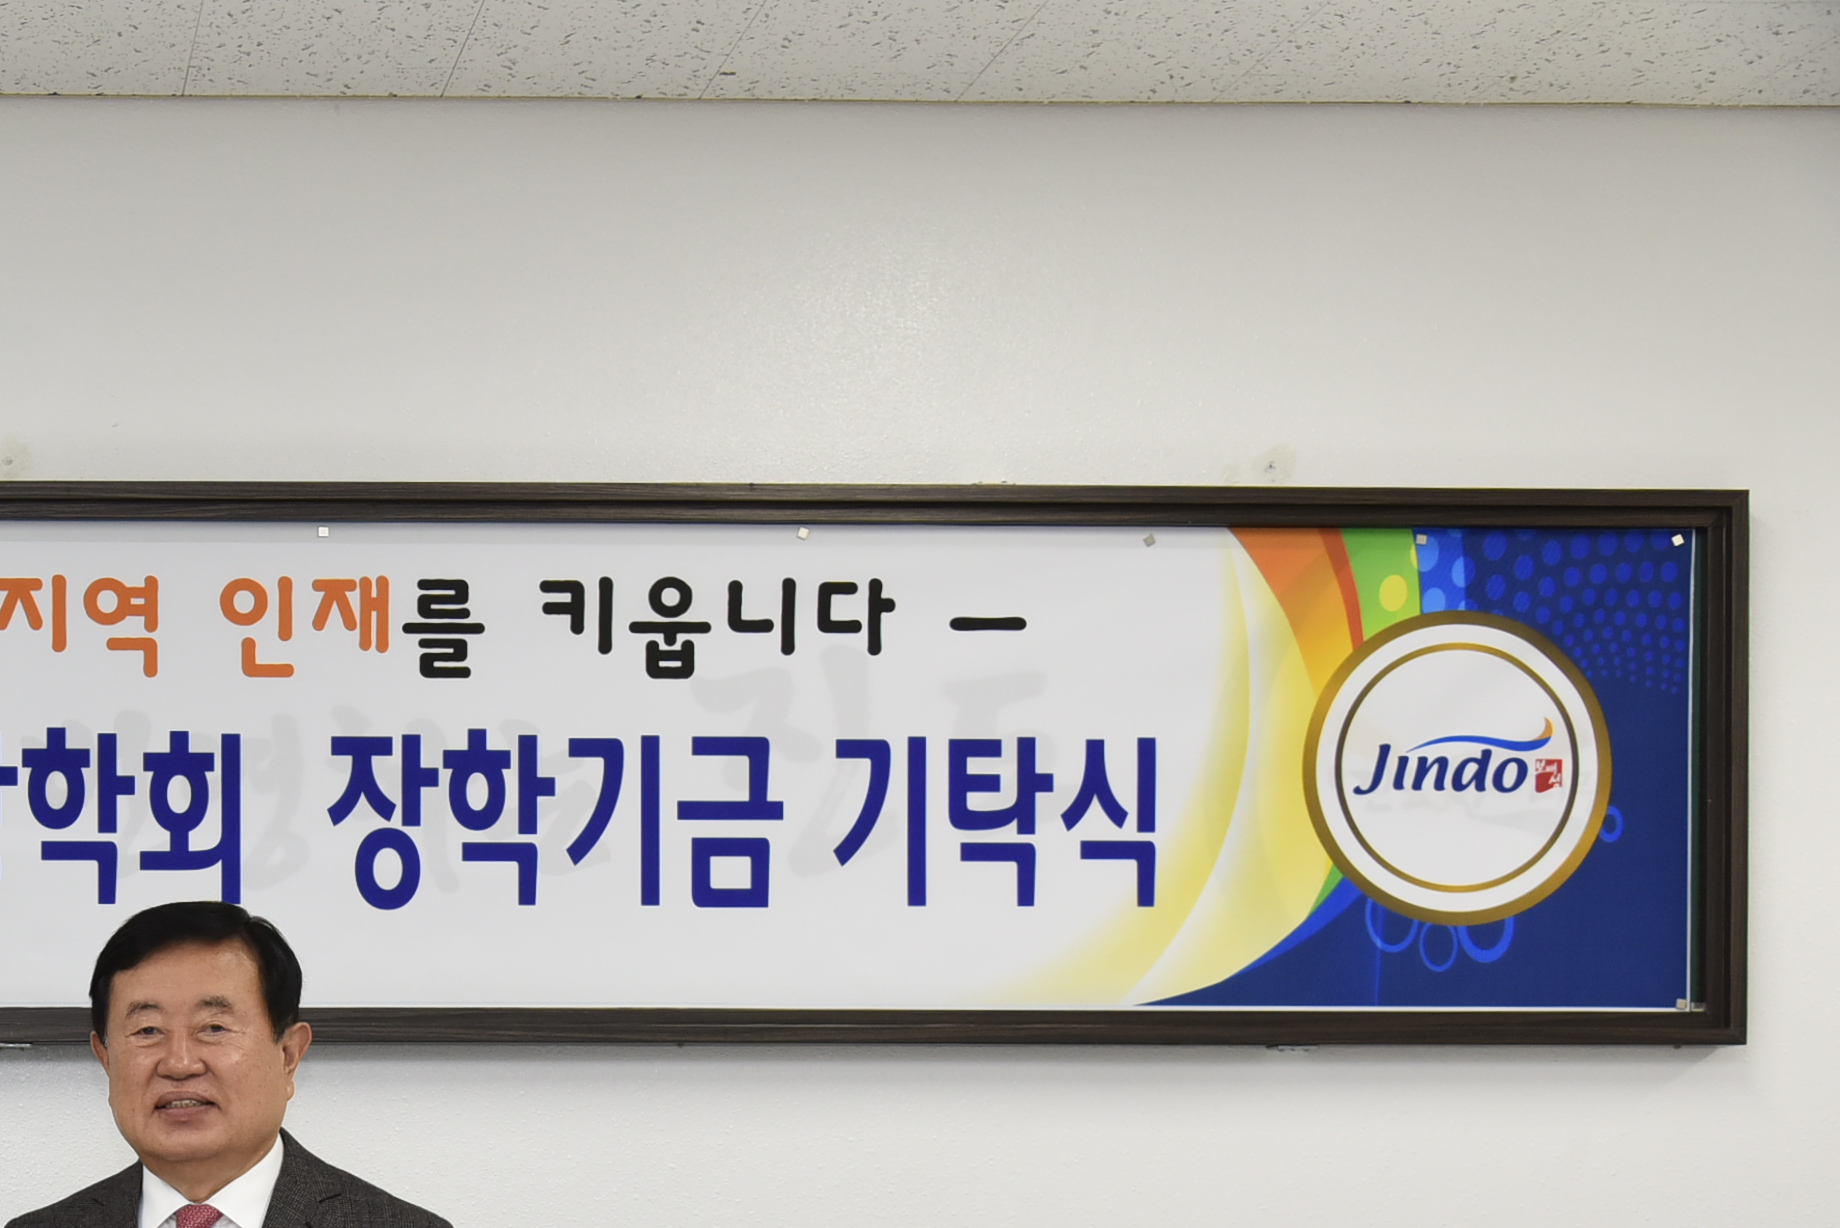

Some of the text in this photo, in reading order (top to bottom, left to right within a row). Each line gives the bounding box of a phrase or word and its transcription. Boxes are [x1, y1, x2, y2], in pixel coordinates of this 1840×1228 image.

[220, 576, 487, 680] 인재를
[540, 577, 897, 681] 키웁니다
[327, 729, 785, 911] 장학기금
[834, 737, 1158, 909] 기탁식
[1353, 744, 1529, 796] Jindo
